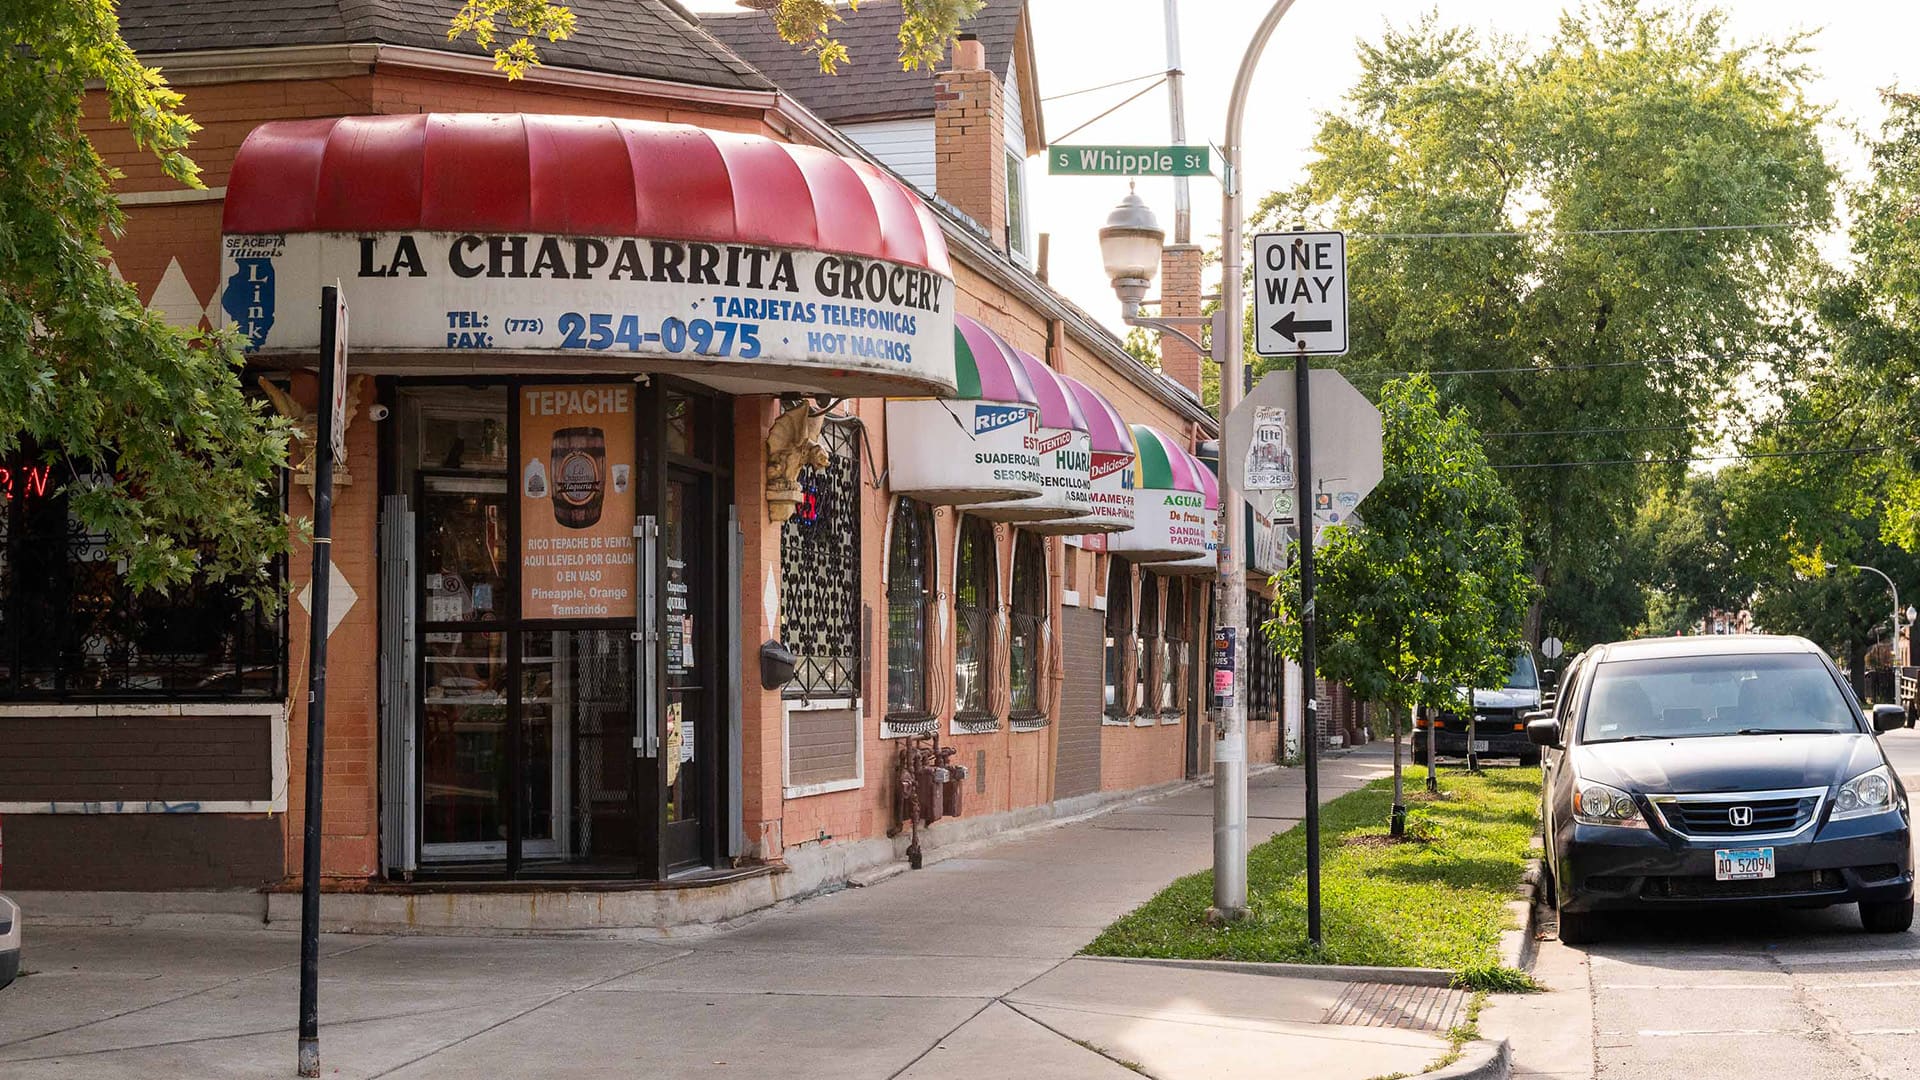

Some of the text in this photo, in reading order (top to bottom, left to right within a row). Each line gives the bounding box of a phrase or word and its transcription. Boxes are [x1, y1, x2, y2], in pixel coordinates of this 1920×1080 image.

[1059, 150, 1200, 174] S Whipple St
[226, 238, 286, 248] SE ACEPTA
[228, 248, 283, 258] Illinois
[1265, 243, 1333, 271] ONE
[358, 235, 942, 315] LA CHAPARRITA GROCERY
[1265, 276, 1334, 305] WAY
[247, 264, 269, 339] Link
[447, 311, 488, 329] TEL:
[713, 296, 916, 336] TARJETAS TELEFONICAS
[447, 332, 493, 349] FAX:
[504, 312, 761, 359] (773) 254-0975
[808, 332, 912, 364] HOT NACHOS
[526, 389, 628, 416] TEPACHE
[976, 408, 1026, 431] Ricos
[1260, 429, 1280, 442] Lite
[1163, 495, 1202, 508] AGUAS
[528, 537, 632, 550] RICO TEPACHE DE VENTA
[525, 553, 634, 566] AQUI LLEVELO POR GALON
[557, 570, 601, 582] O EN VASO
[531, 587, 627, 600] Pineapple, Orange
[552, 603, 608, 615] Tamarindo
[1738, 857, 1772, 873] 52094
